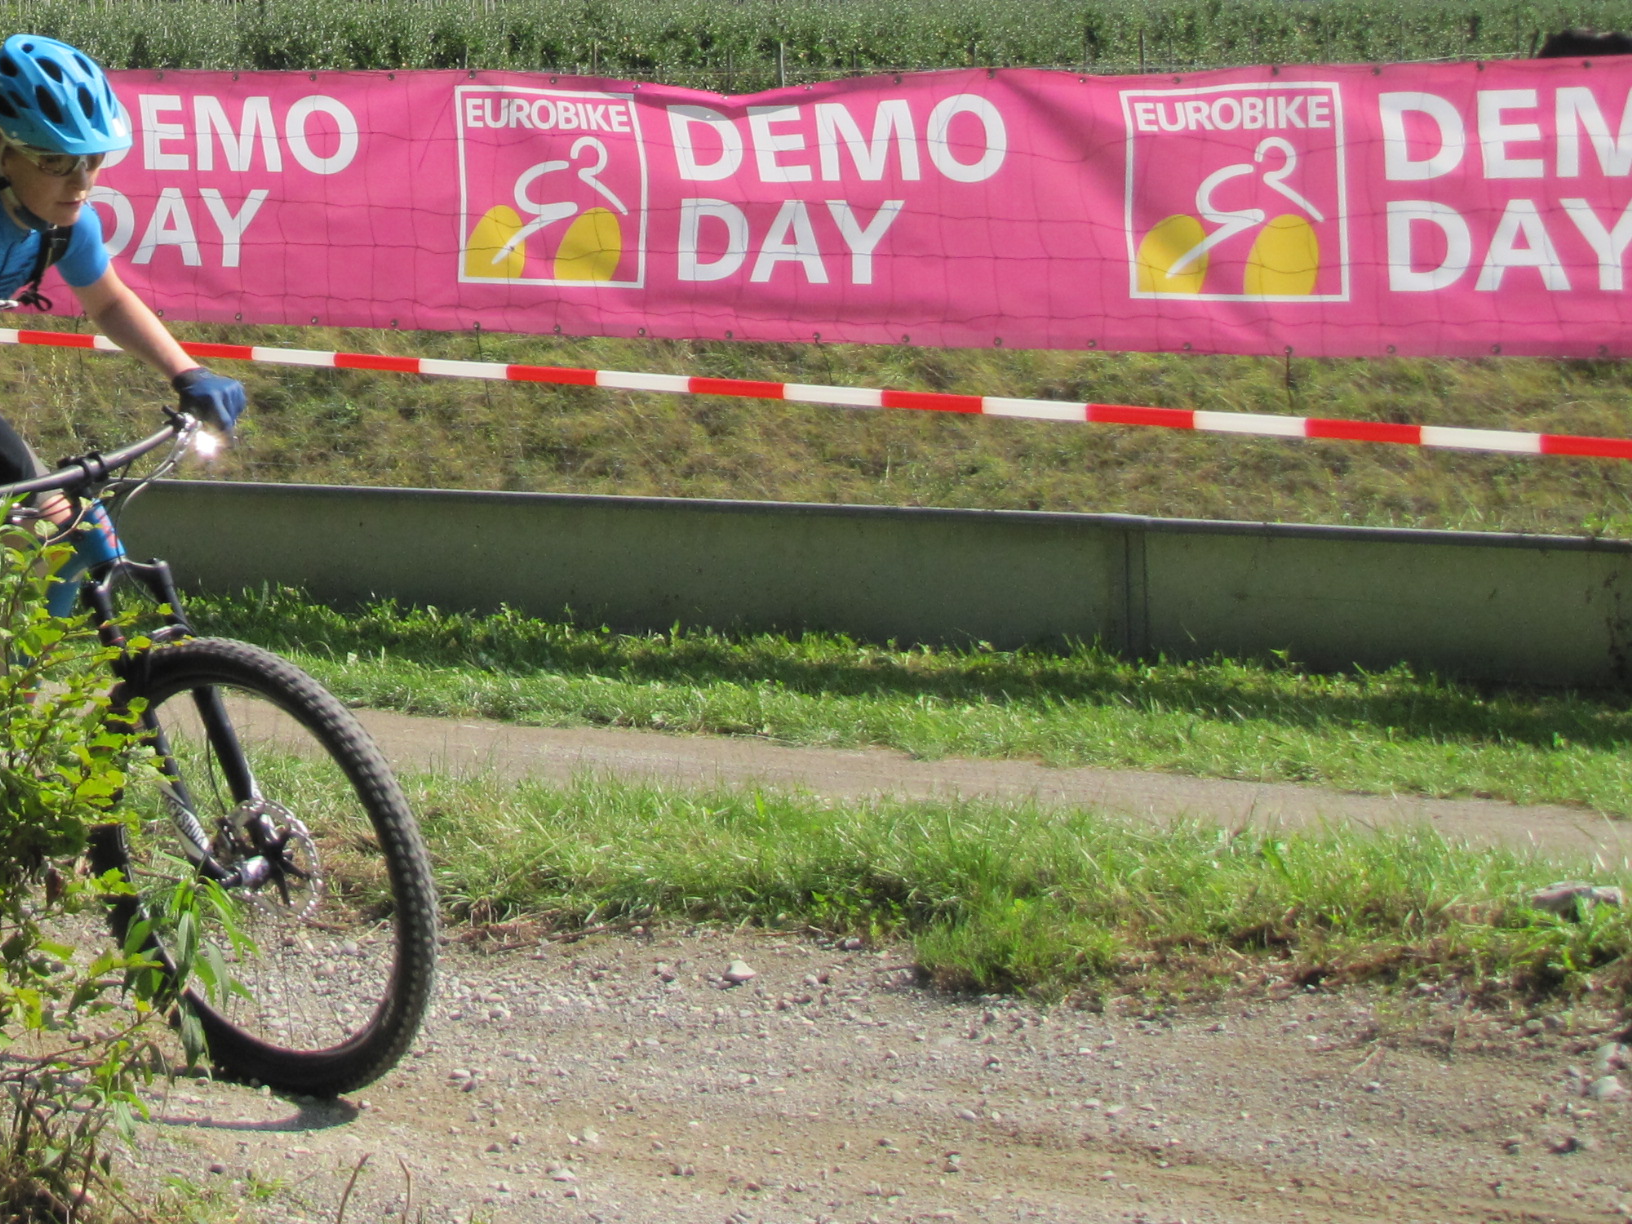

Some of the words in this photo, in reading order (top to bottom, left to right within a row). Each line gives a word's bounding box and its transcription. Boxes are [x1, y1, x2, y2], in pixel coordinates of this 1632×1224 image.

[466, 97, 631, 134] EUROBIKE
[667, 93, 1008, 183] DEMO
[1134, 95, 1331, 132] EUROBIKE
[1378, 86, 1632, 181] DEM
[677, 198, 905, 284] DAY
[1386, 197, 1632, 292] DAY
